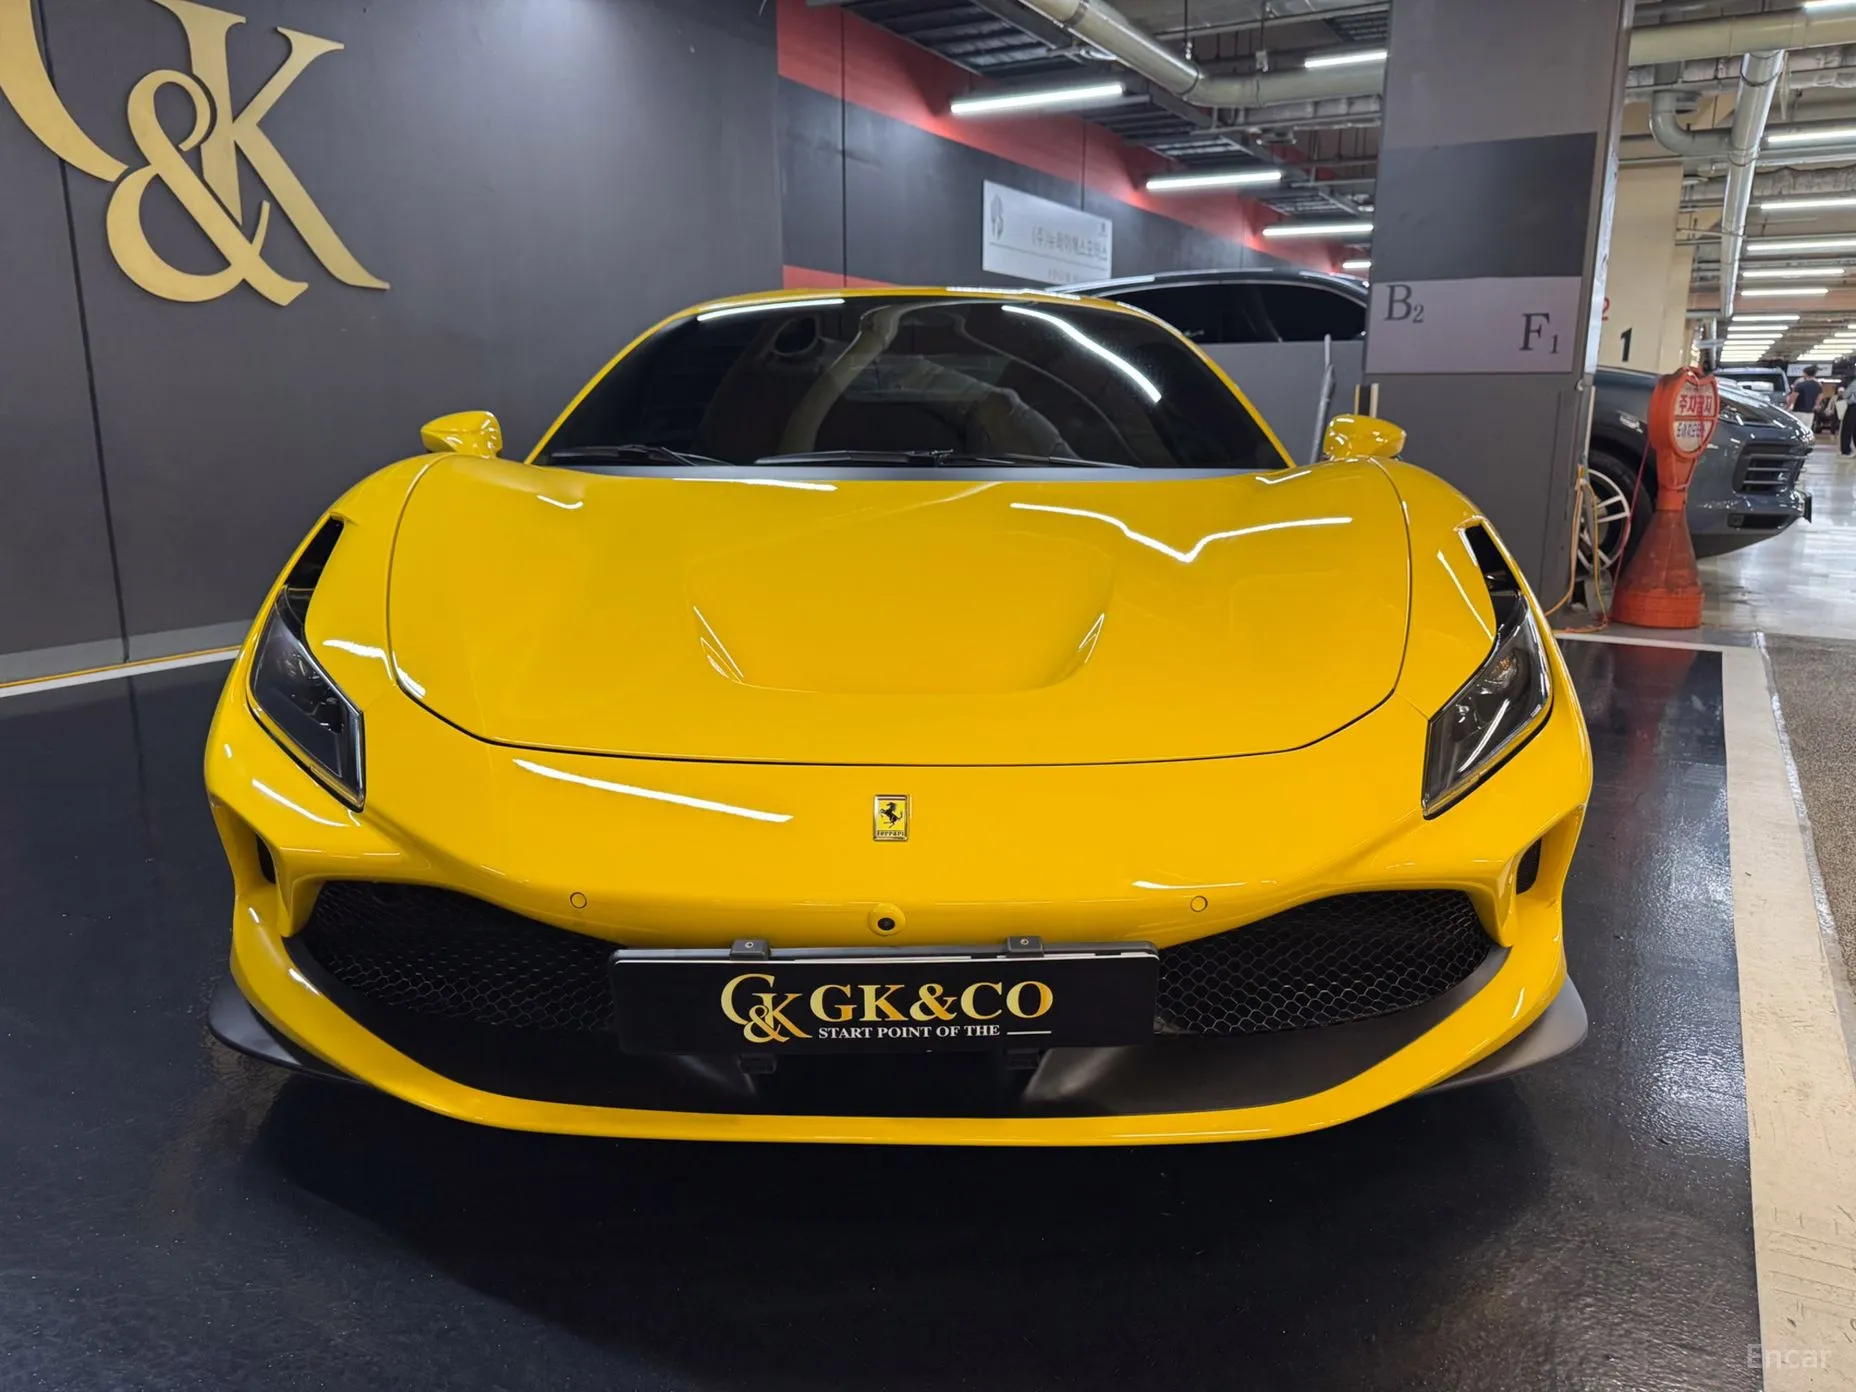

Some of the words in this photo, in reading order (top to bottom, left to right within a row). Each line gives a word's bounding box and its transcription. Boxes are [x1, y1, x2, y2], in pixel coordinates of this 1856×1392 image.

[1620, 327, 1632, 362] 1
[809, 980, 1054, 1023] GK&CO
[818, 1027, 873, 1039] START
[877, 1026, 932, 1038] POINT
[936, 1025, 960, 1037] OF
[964, 1024, 1000, 1036] THE
